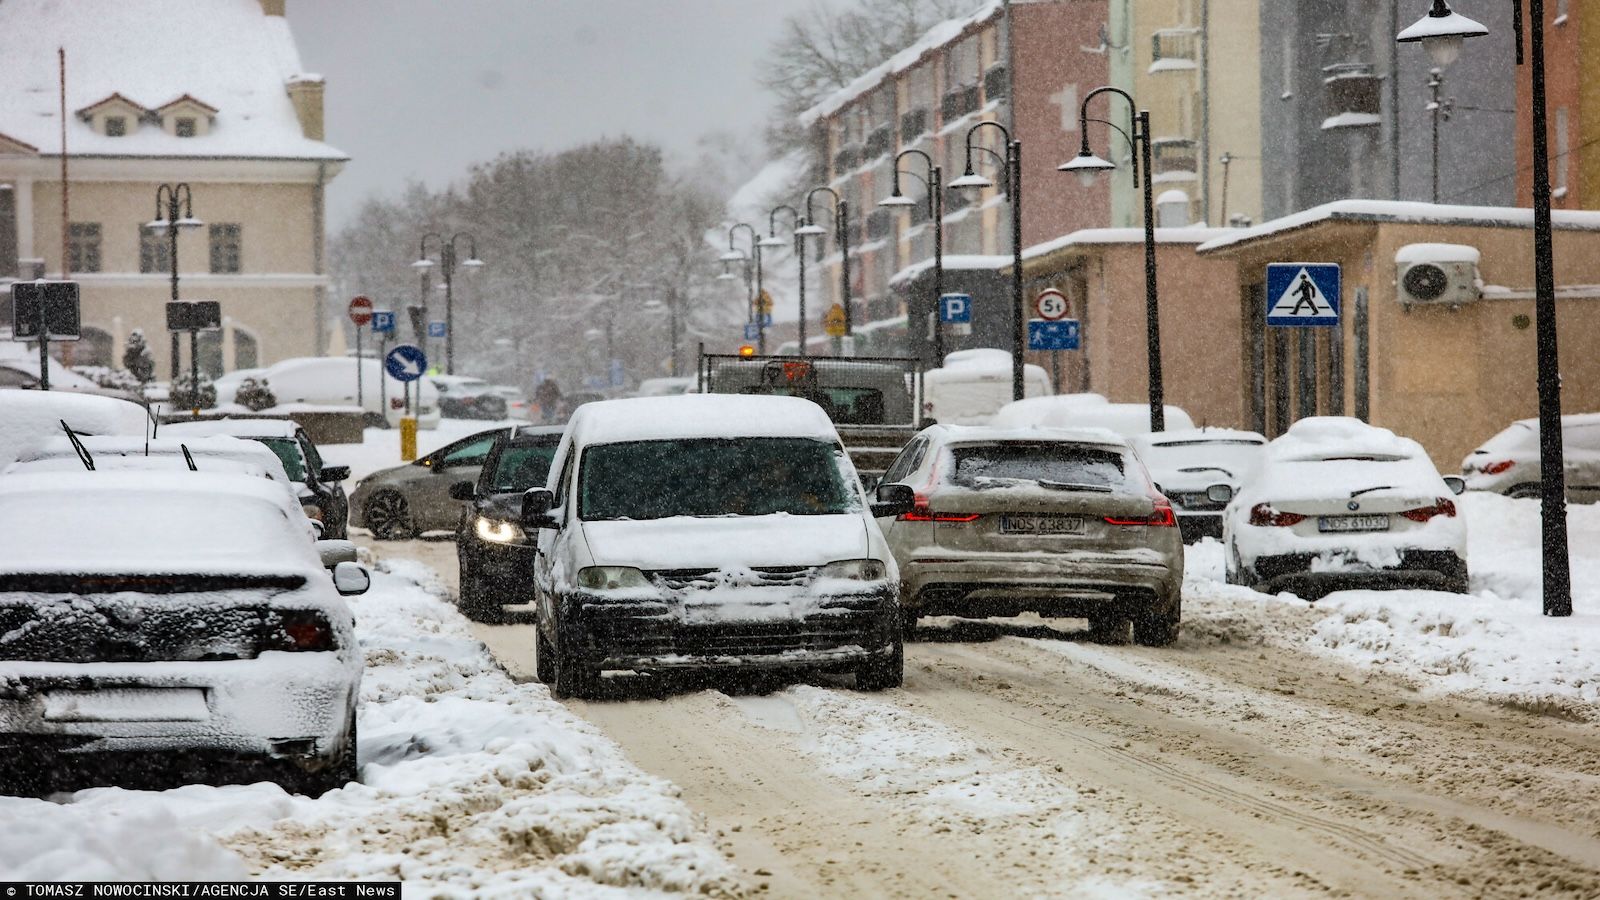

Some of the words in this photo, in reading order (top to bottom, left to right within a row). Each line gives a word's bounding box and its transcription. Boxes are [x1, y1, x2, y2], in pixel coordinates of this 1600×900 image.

[947, 299, 965, 319] P
[376, 313, 390, 329] P
[1008, 519, 1035, 530] NOS
[1039, 519, 1081, 531] 63837
